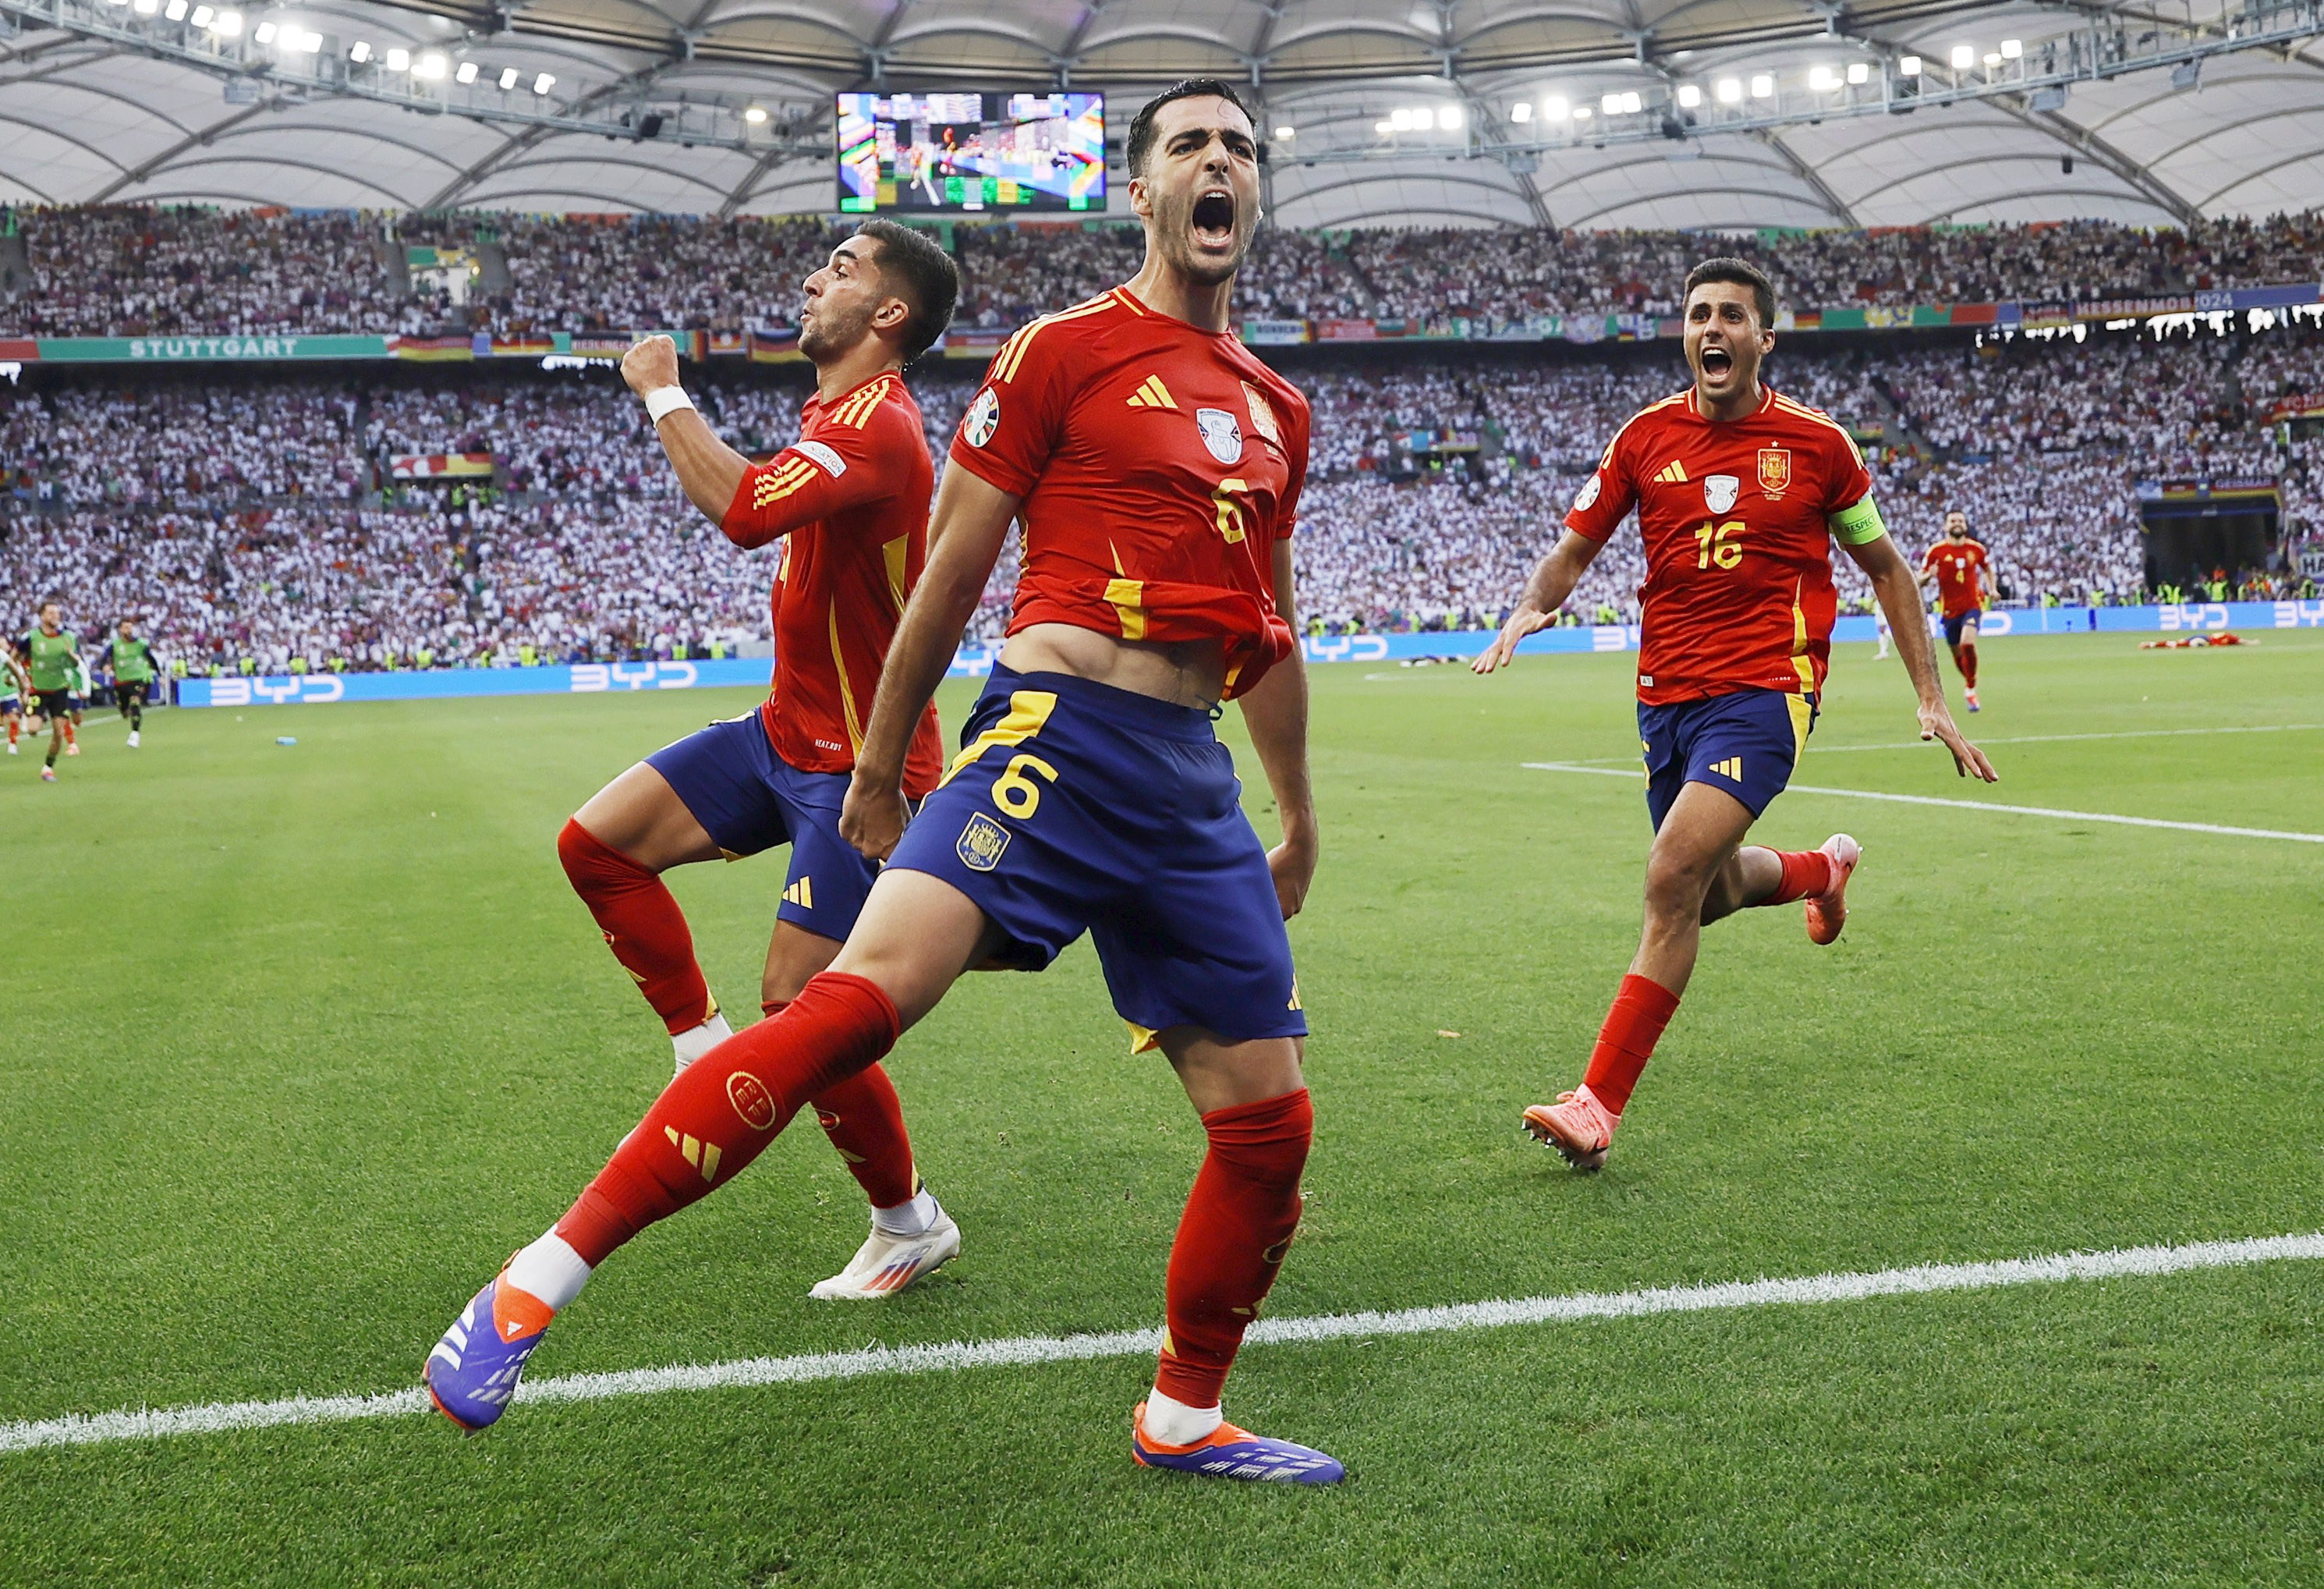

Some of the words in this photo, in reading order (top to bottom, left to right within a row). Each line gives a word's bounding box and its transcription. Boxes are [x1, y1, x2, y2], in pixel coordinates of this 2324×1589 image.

[129, 339, 298, 358] STUTTGART
[1211, 478, 1249, 544] 6
[1695, 520, 1746, 569] 16
[2159, 603, 2229, 630] BYD
[1300, 636, 1388, 662] YD
[210, 675, 345, 706] BYD
[570, 661, 698, 692] BYD
[991, 754, 1059, 819] 6
